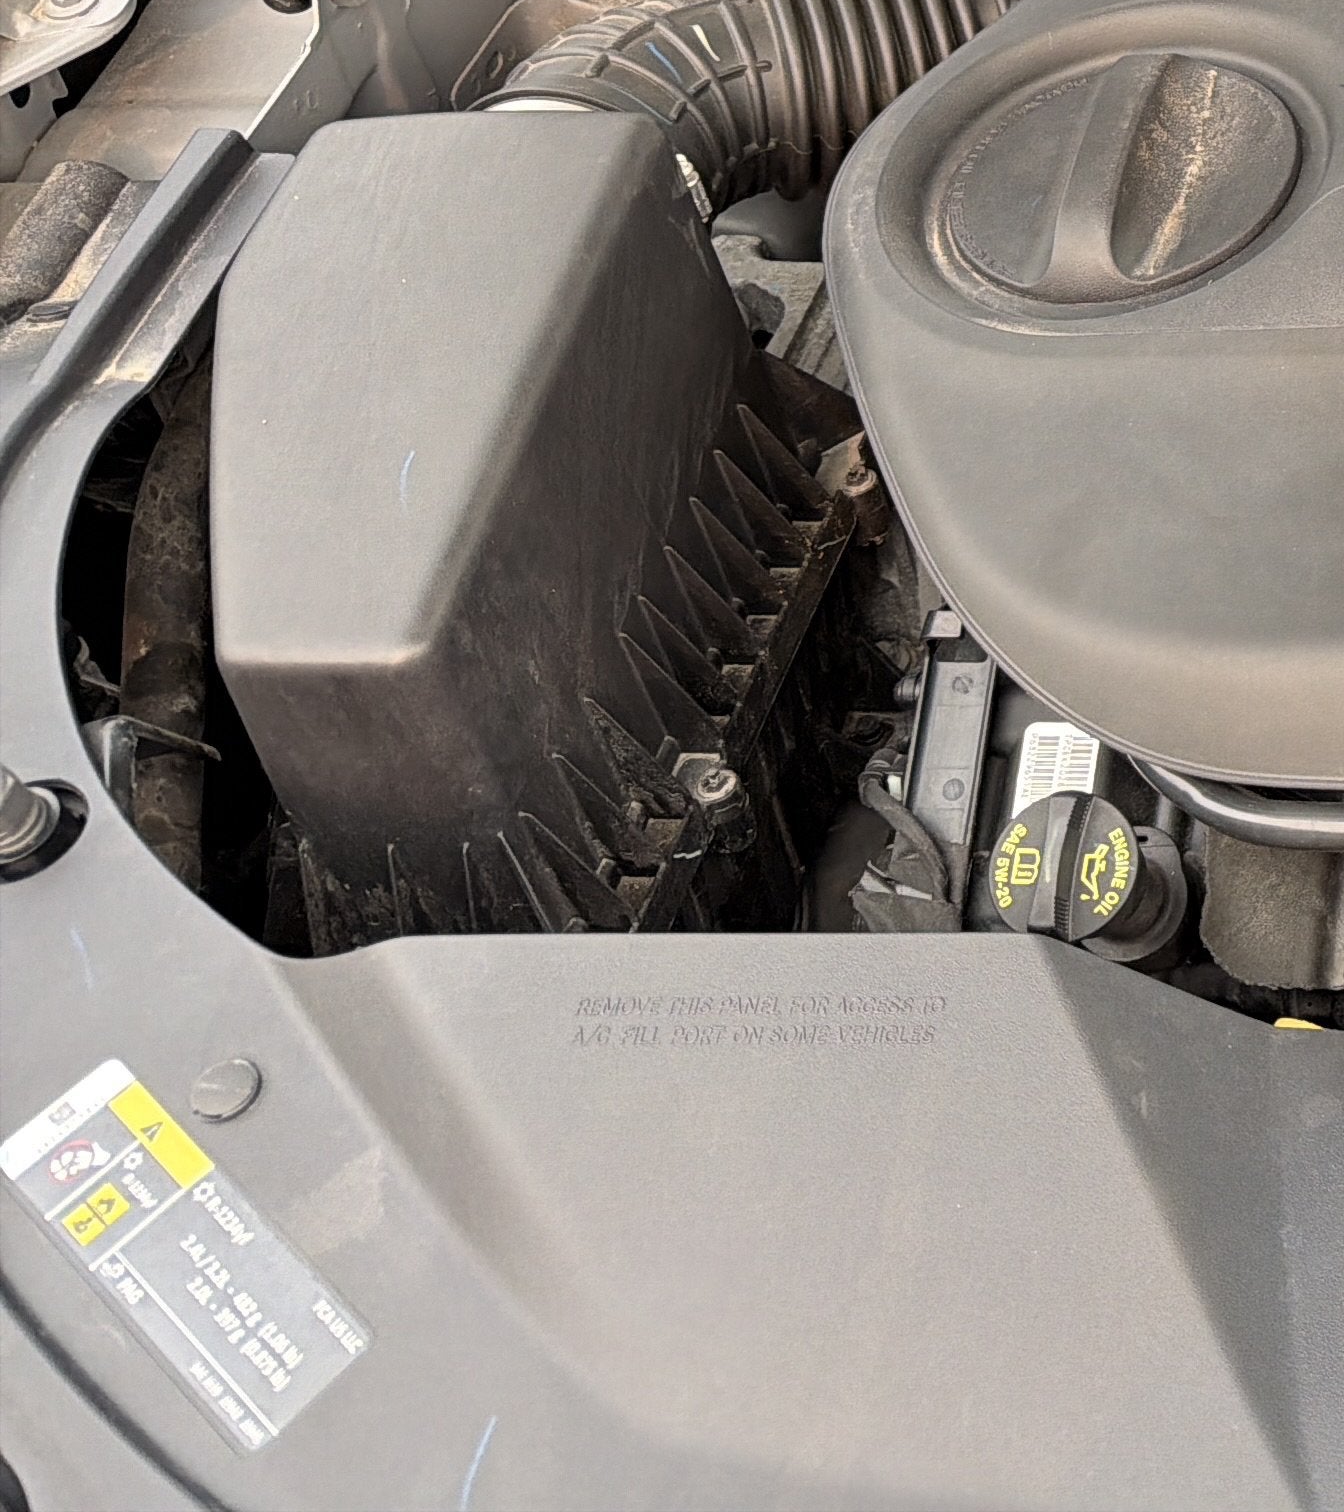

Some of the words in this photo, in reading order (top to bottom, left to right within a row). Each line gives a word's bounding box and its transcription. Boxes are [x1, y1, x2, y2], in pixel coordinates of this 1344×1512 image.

[1000, 823, 1028, 856] SAE
[1108, 827, 1131, 889] ENGINE
[994, 856, 1014, 909] 5W-20
[1093, 891, 1120, 917] OIL
[575, 996, 663, 1016] REMOVE
[668, 996, 714, 1016] THIS
[719, 995, 780, 1015] PANEL
[789, 996, 830, 1015] FOR
[838, 996, 914, 1014] ACCESS
[919, 995, 947, 1015] TO
[620, 1025, 662, 1046] FILL
[670, 1025, 727, 1046] PORT
[733, 1025, 764, 1045] ON
[769, 1025, 831, 1045] SOME
[837, 1025, 936, 1045] VEHICLES
